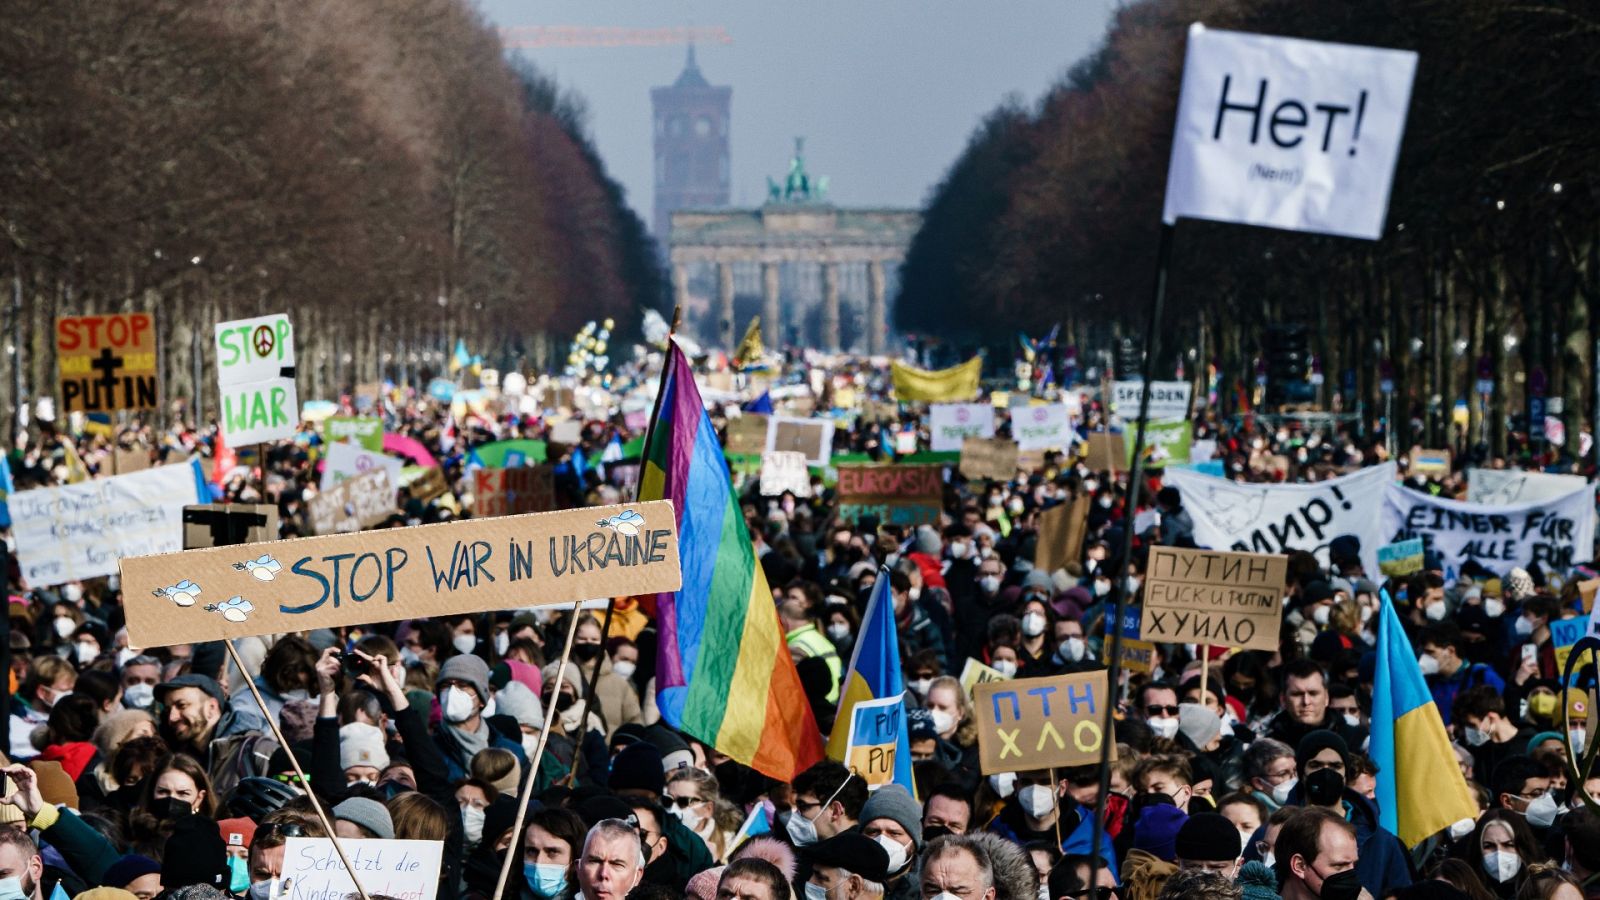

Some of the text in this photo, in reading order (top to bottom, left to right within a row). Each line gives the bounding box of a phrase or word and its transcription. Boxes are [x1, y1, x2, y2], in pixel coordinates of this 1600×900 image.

[1212, 73, 1369, 157] Нет!
[58, 316, 149, 350] STOP
[219, 319, 290, 366] STOP
[62, 374, 157, 412] PUTIN
[225, 387, 288, 433] WAR
[1406, 505, 1512, 534] EINER
[279, 547, 408, 614] STOP
[425, 540, 496, 592] WAR
[549, 529, 672, 577] UKRAINE
[1153, 551, 1269, 582] ПУТИН
[1151, 584, 1205, 603] FUCK
[991, 683, 1096, 724] ПТН
[996, 719, 1102, 760] ХЛО
[395, 851, 420, 872] die
